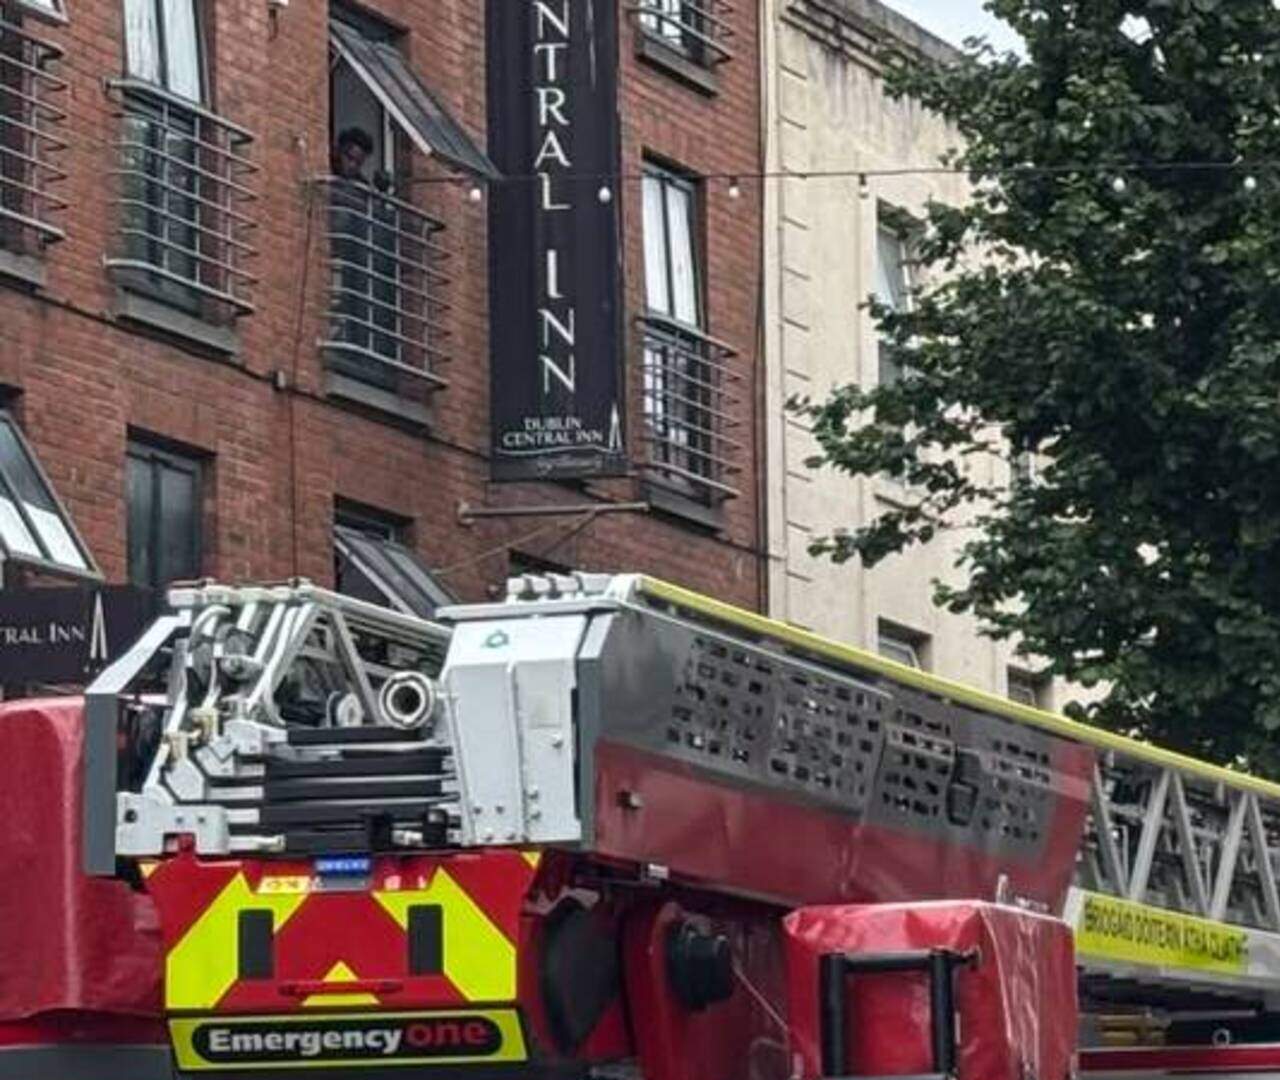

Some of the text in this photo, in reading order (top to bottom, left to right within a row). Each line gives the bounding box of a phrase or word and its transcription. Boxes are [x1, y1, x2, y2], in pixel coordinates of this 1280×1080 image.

[538, 249, 575, 394] INN
[524, 416, 581, 431] DUBLIN
[503, 428, 603, 447] CENTRAL INN
[49, 622, 85, 642] INN
